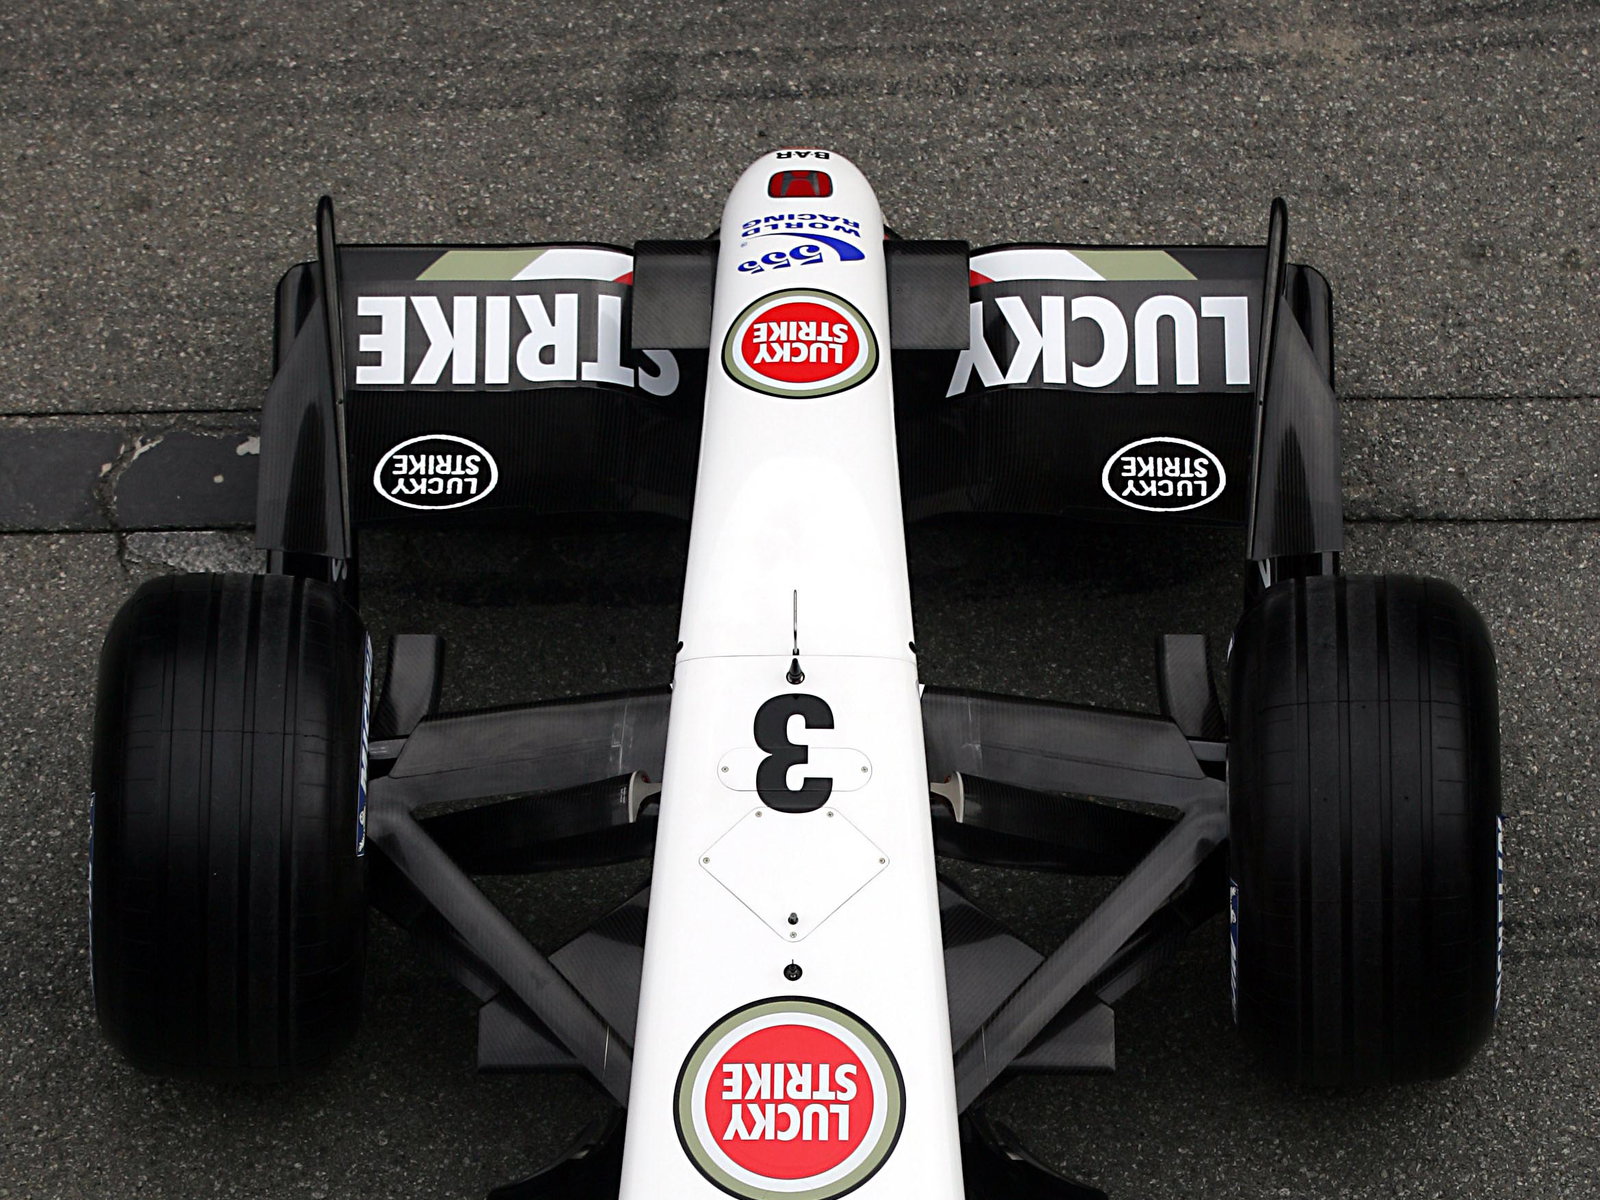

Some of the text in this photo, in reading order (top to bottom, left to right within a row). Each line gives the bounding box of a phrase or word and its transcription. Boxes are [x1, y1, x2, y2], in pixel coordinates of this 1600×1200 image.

[741, 222, 861, 239] WORLD
[742, 213, 860, 229] RACING
[737, 244, 824, 275] 555
[752, 321, 848, 343] STRIKE
[753, 342, 844, 365] LUCKY
[946, 294, 1251, 398] LUCKY
[392, 455, 482, 475] STRIKE
[1121, 456, 1209, 476] STRIKE
[391, 477, 478, 496] LUCKY
[1122, 479, 1208, 497] LUCKY
[753, 693, 835, 814] 3
[722, 1061, 858, 1101] STRIKE
[722, 1102, 850, 1142] LUCKY
